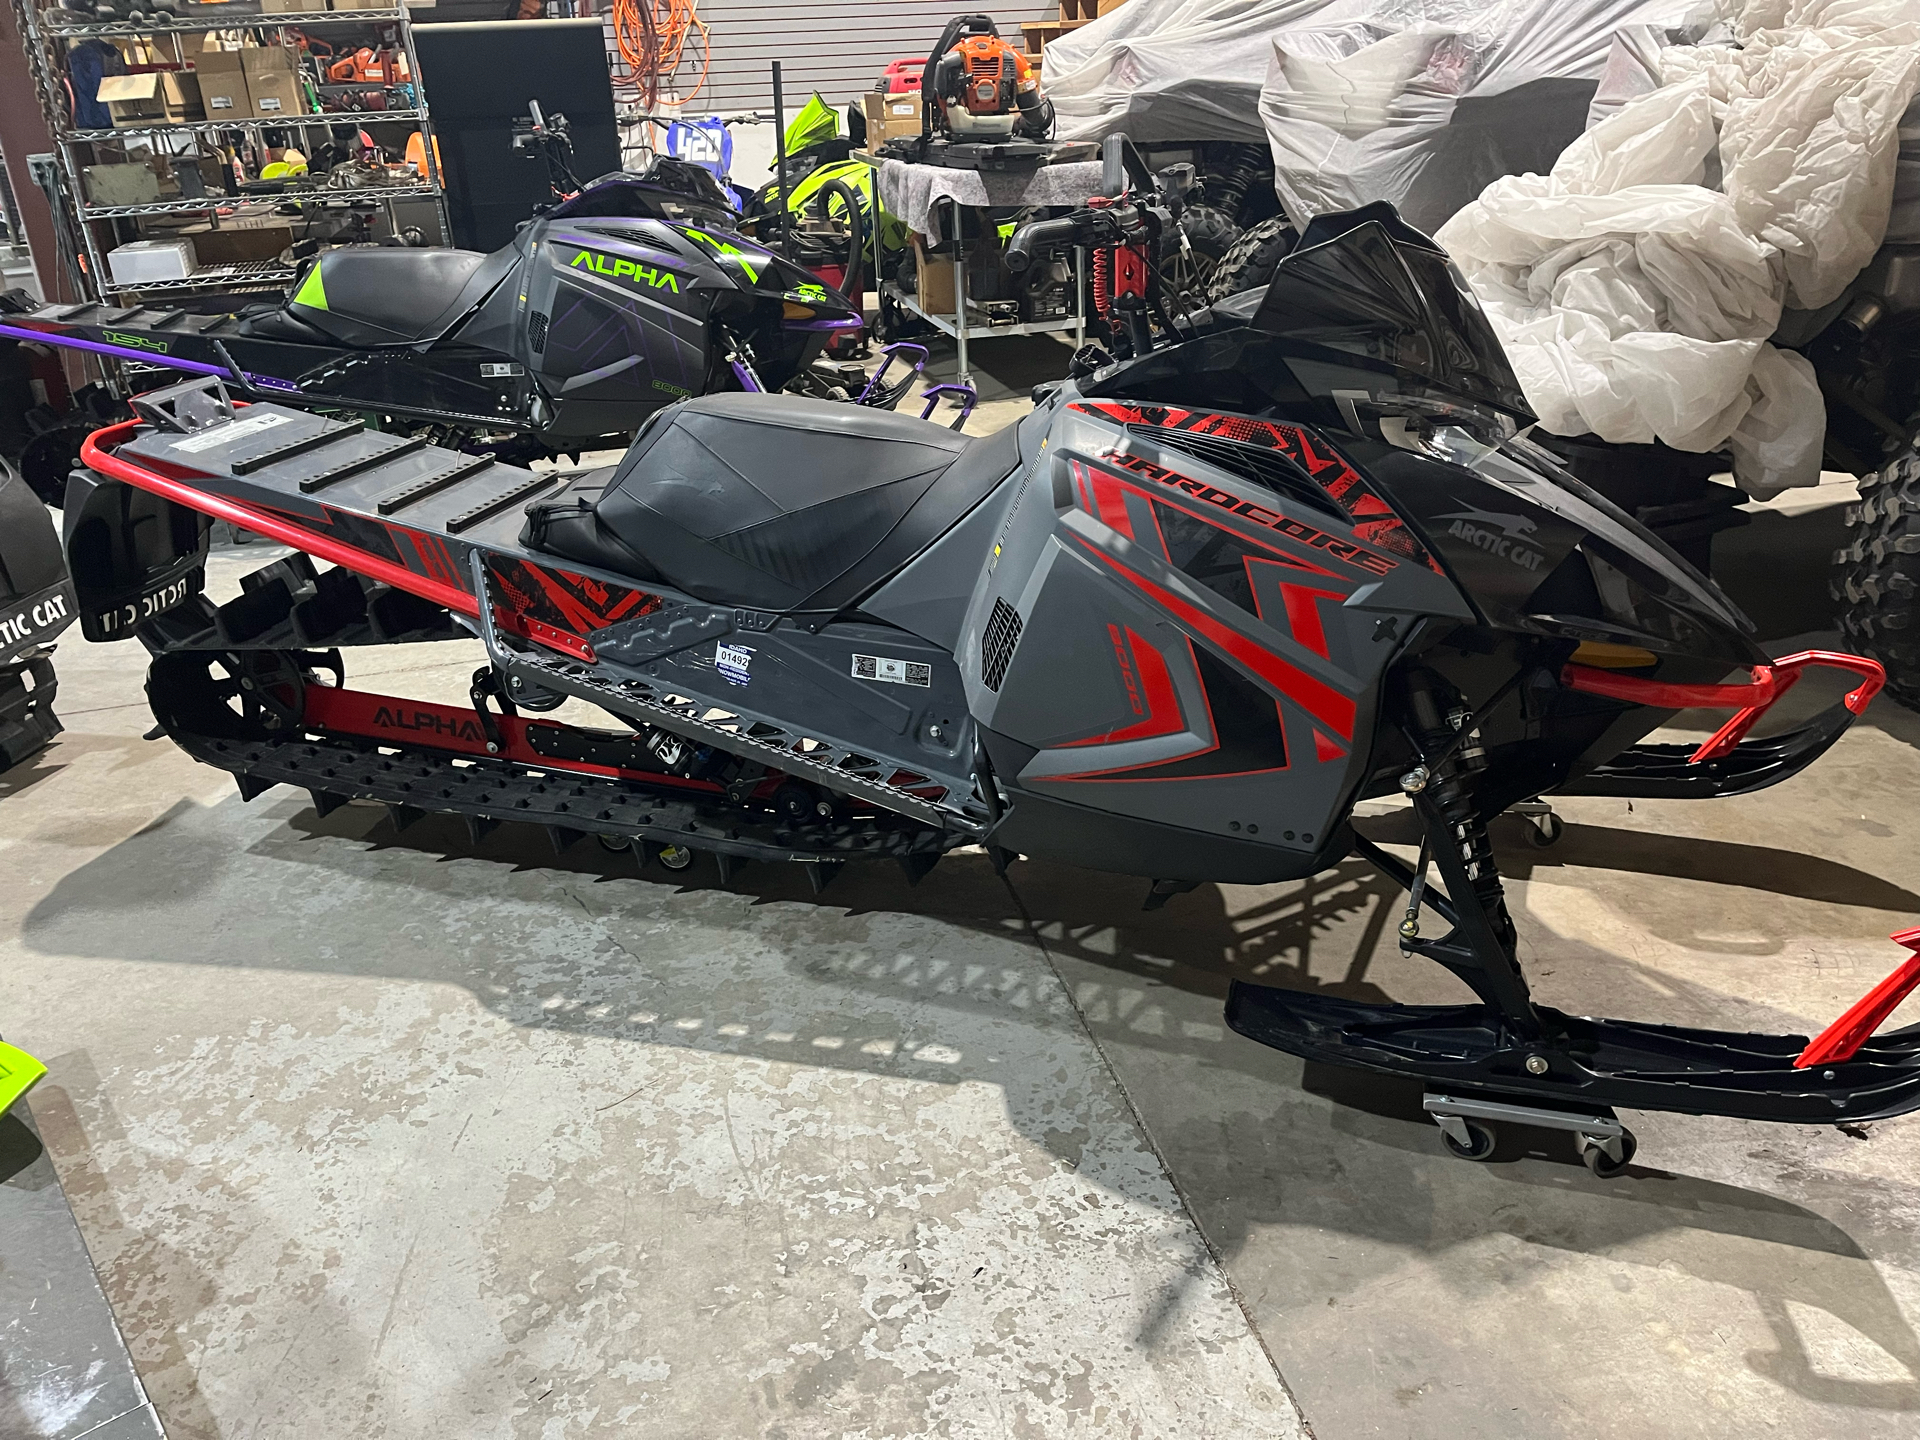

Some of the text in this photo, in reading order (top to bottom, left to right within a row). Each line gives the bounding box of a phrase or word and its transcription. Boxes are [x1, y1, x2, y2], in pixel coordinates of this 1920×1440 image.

[677, 127, 722, 162] 420
[570, 250, 679, 294] ALPHA
[102, 330, 168, 353] 154
[1100, 449, 1400, 576] HARDCORE
[1448, 519, 1545, 571] ARCTIC CAT
[0, 594, 68, 649] TIC CAT
[721, 651, 748, 667] 01492
[728, 644, 748, 654] IDAHO
[373, 706, 482, 741] ALPHA
